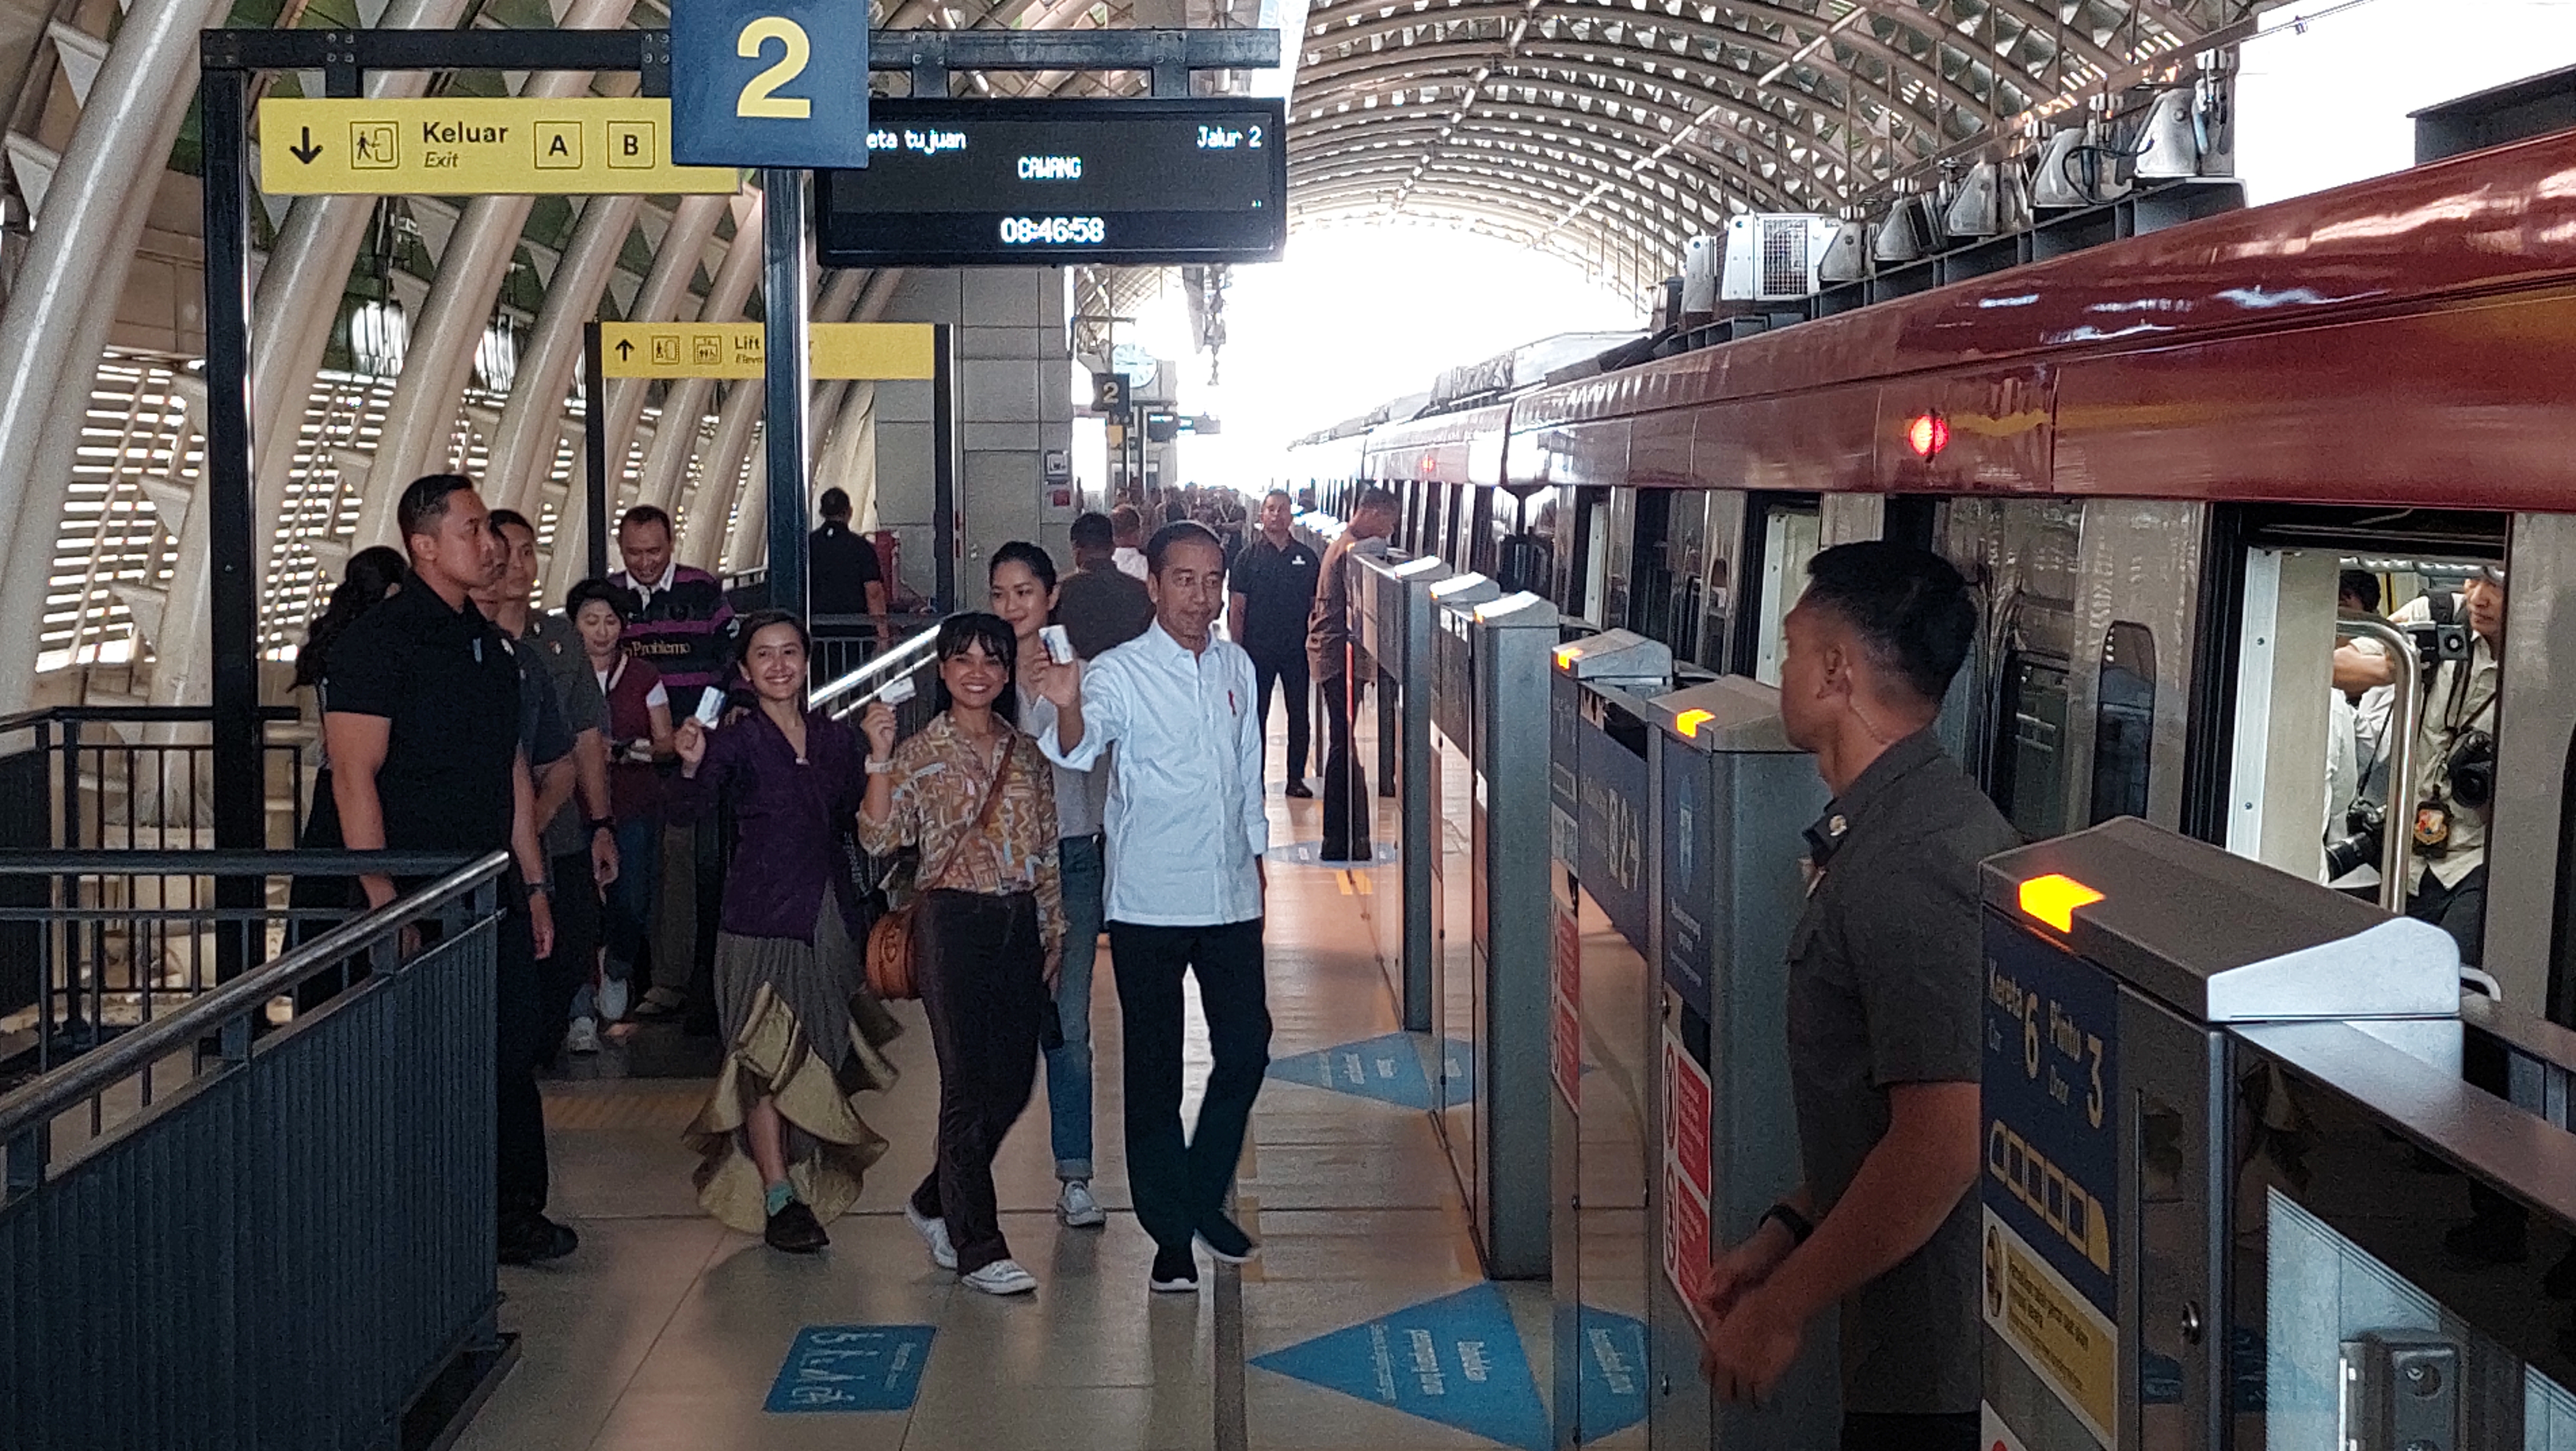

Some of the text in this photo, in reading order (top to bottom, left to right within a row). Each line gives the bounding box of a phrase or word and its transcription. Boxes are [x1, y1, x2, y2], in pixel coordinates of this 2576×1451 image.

[736, 17, 811, 119] 2
[422, 121, 509, 144] Keluar
[866, 129, 967, 155] eta tujuan
[1197, 125, 1262, 149] Jalur 2
[548, 134, 569, 157] A
[623, 134, 639, 157] B
[423, 150, 459, 169] Exit
[1018, 156, 1081, 179] CAWANG
[1000, 217, 1105, 243] 08:46:58
[735, 336, 760, 350] Lift
[1103, 382, 1119, 403] 2
[2025, 992, 2039, 1079] 6
[2050, 999, 2081, 1062] Pintu
[2087, 1033, 2104, 1129] 3
